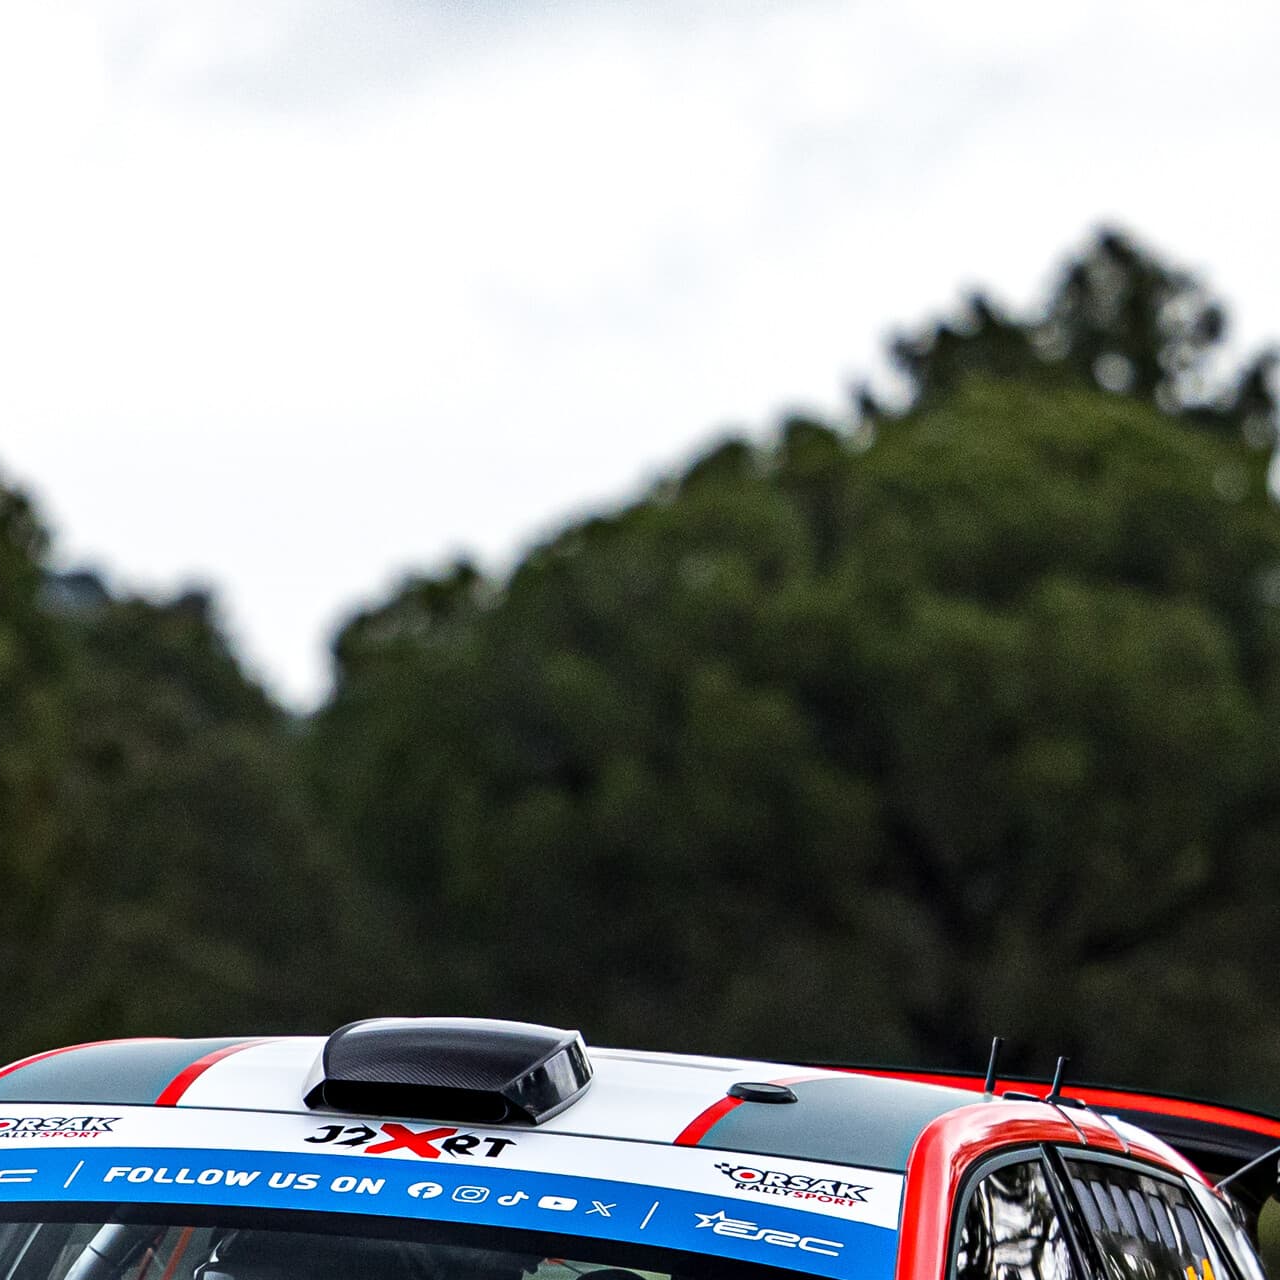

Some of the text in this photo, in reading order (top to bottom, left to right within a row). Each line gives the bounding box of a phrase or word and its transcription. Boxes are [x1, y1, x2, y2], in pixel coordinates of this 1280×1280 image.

[103, 1166, 386, 1197] FOLLOW US ON
[729, 1166, 874, 1203] ORSAK
[734, 1182, 857, 1208] RALLYSPORT
